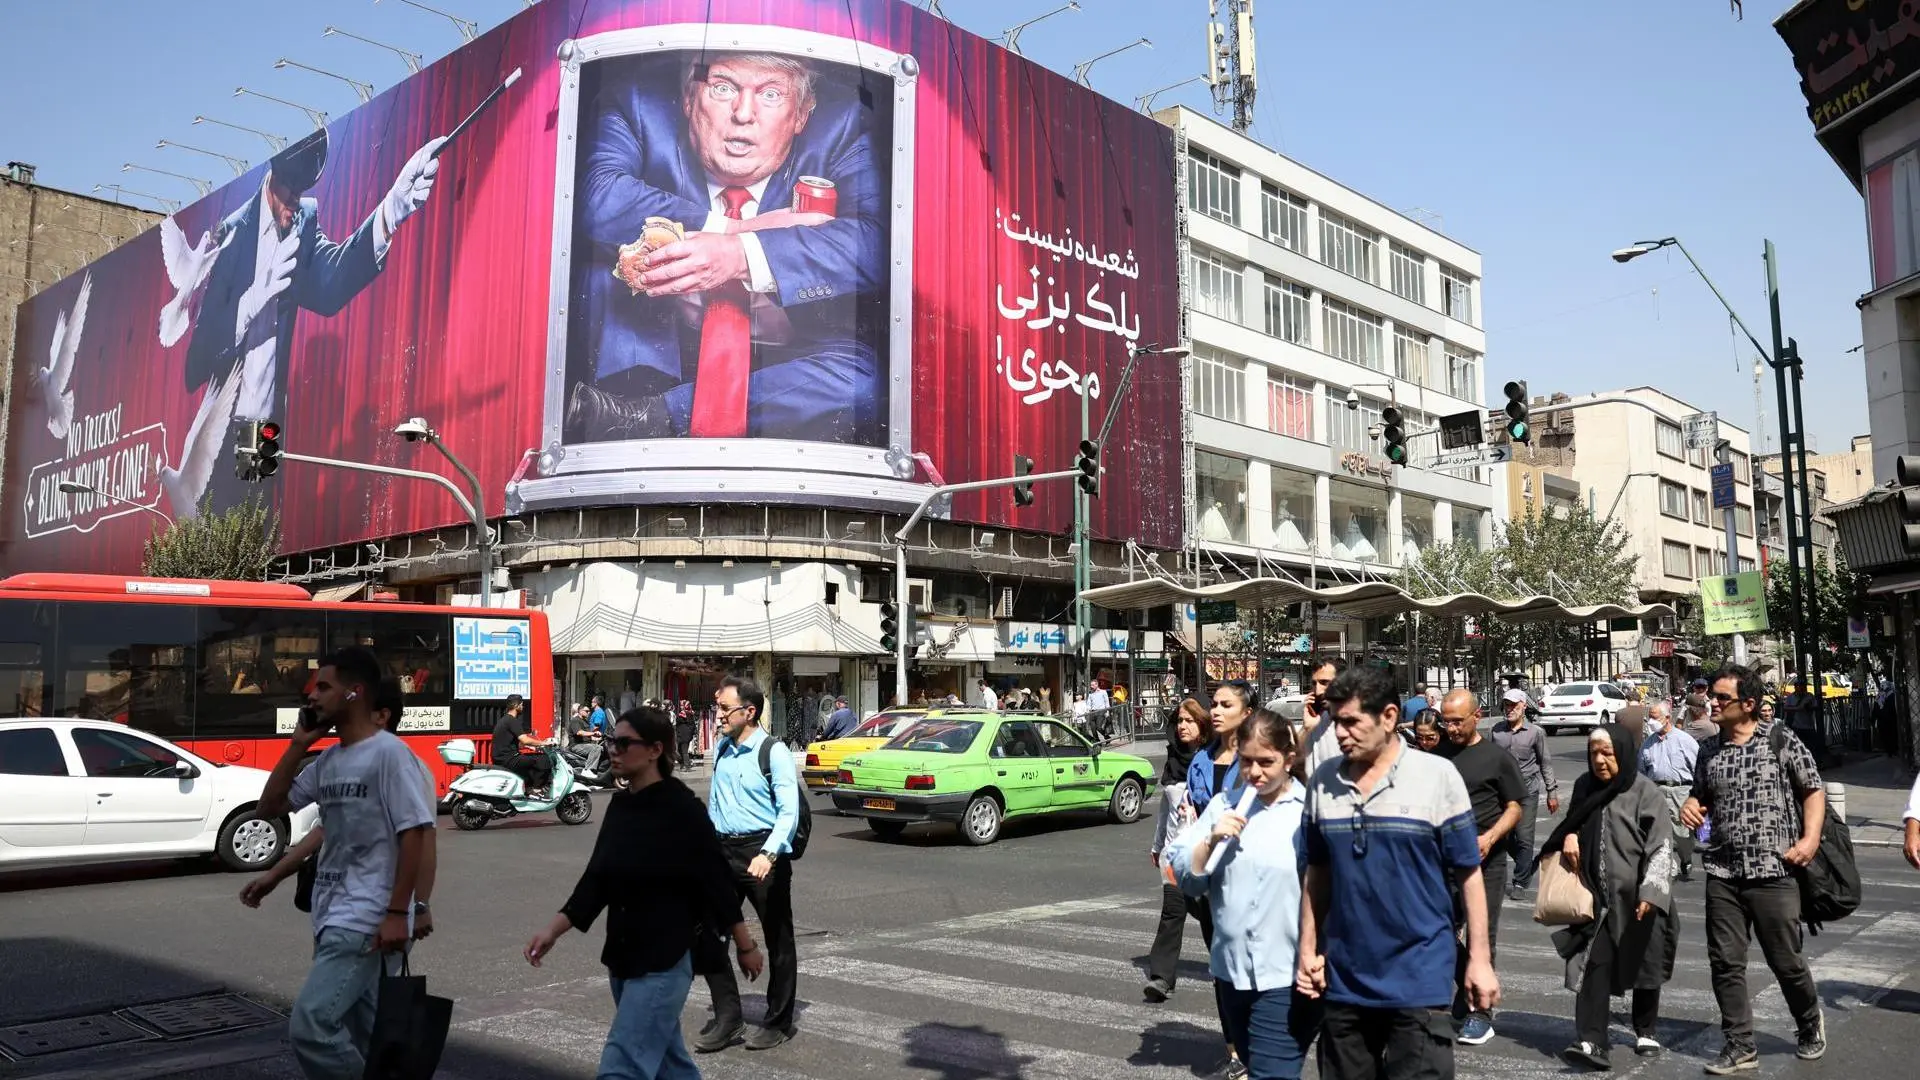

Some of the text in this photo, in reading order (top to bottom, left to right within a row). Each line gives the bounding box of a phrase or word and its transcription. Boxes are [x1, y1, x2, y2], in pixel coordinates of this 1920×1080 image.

[996, 207, 1139, 280] شعبده نیست!
[996, 264, 1140, 358] پلک بزنی
[996, 334, 1100, 405] محوی!
[66, 402, 122, 460] NO TRICKS!
[1427, 455, 1480, 469] جمهوری اسلامی
[37, 442, 150, 525] BLINK, YOU'RE GONE!
[1009, 627, 1065, 649] کوه نور
[458, 683, 528, 696] LOVELY TEHRAN
[418, 708, 432, 718] یکی
[433, 708, 445, 718] این
[435, 719, 445, 727] که
